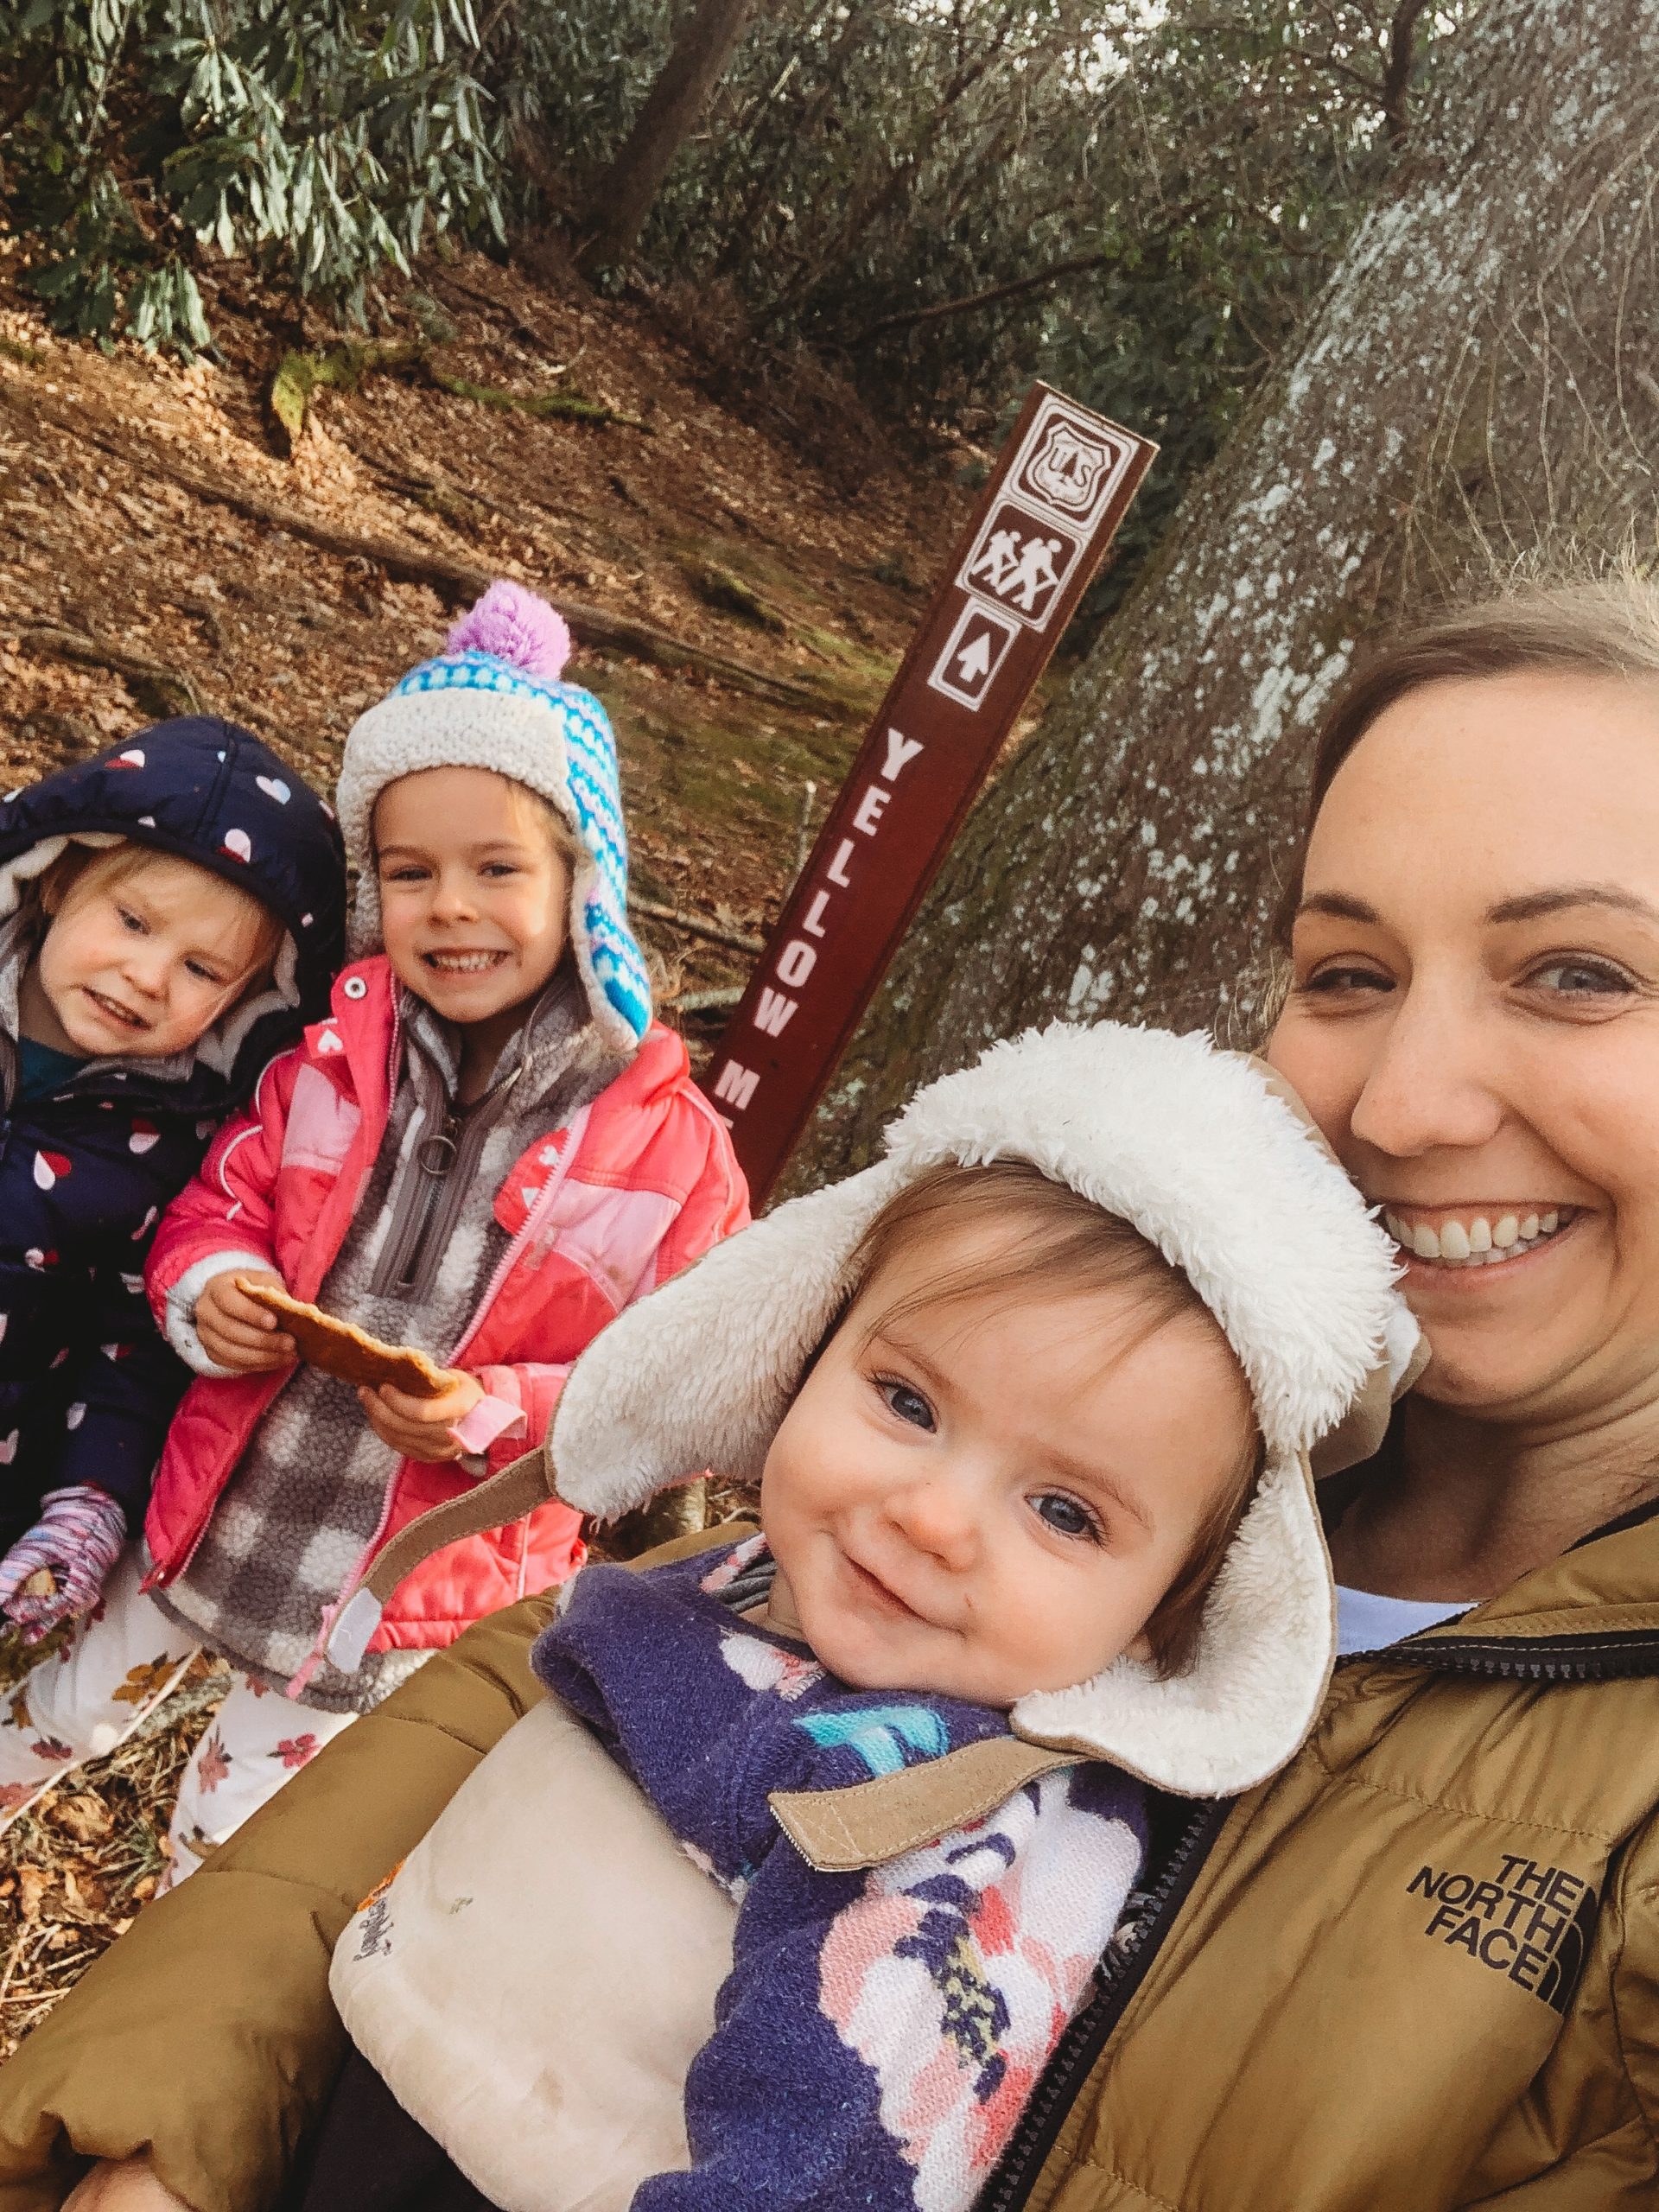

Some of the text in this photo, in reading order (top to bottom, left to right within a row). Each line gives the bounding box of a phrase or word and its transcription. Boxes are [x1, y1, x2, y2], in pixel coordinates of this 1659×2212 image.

[714, 727, 925, 1130] YELLOW M
[1406, 1866, 1569, 1954] NORTH
[1496, 1854, 1585, 1916] THE
[1424, 1904, 1549, 1992] FACE
